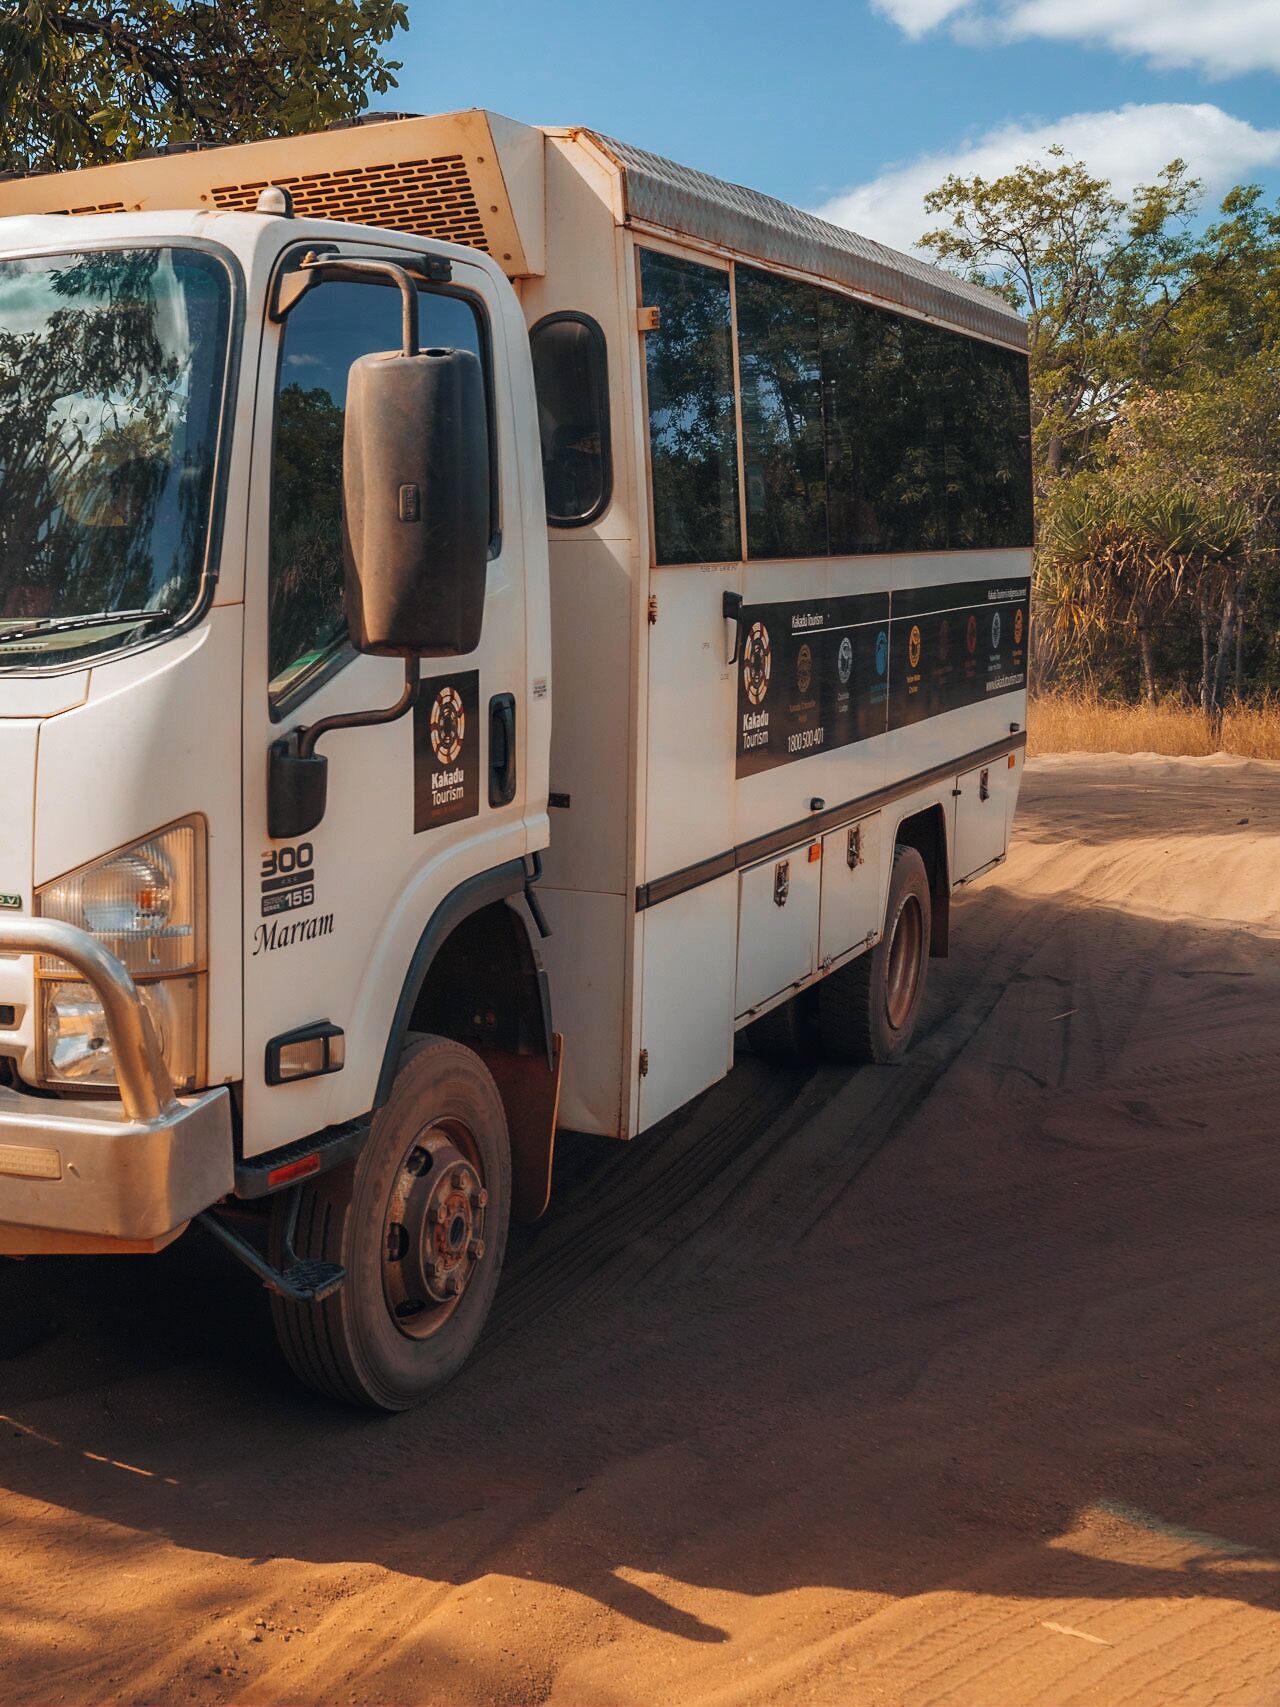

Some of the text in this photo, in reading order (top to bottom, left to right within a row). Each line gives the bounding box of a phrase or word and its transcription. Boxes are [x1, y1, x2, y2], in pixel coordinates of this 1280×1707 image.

[743, 710, 769, 731] Kakadu
[743, 730, 769, 749] Tourism
[788, 727, 824, 753] 1800 500 401
[431, 767, 464, 790] Kakadu
[431, 785, 464, 806] Tourism
[261, 842, 314, 878] 300
[285, 887, 313, 907] 155
[252, 913, 335, 956] Marram
